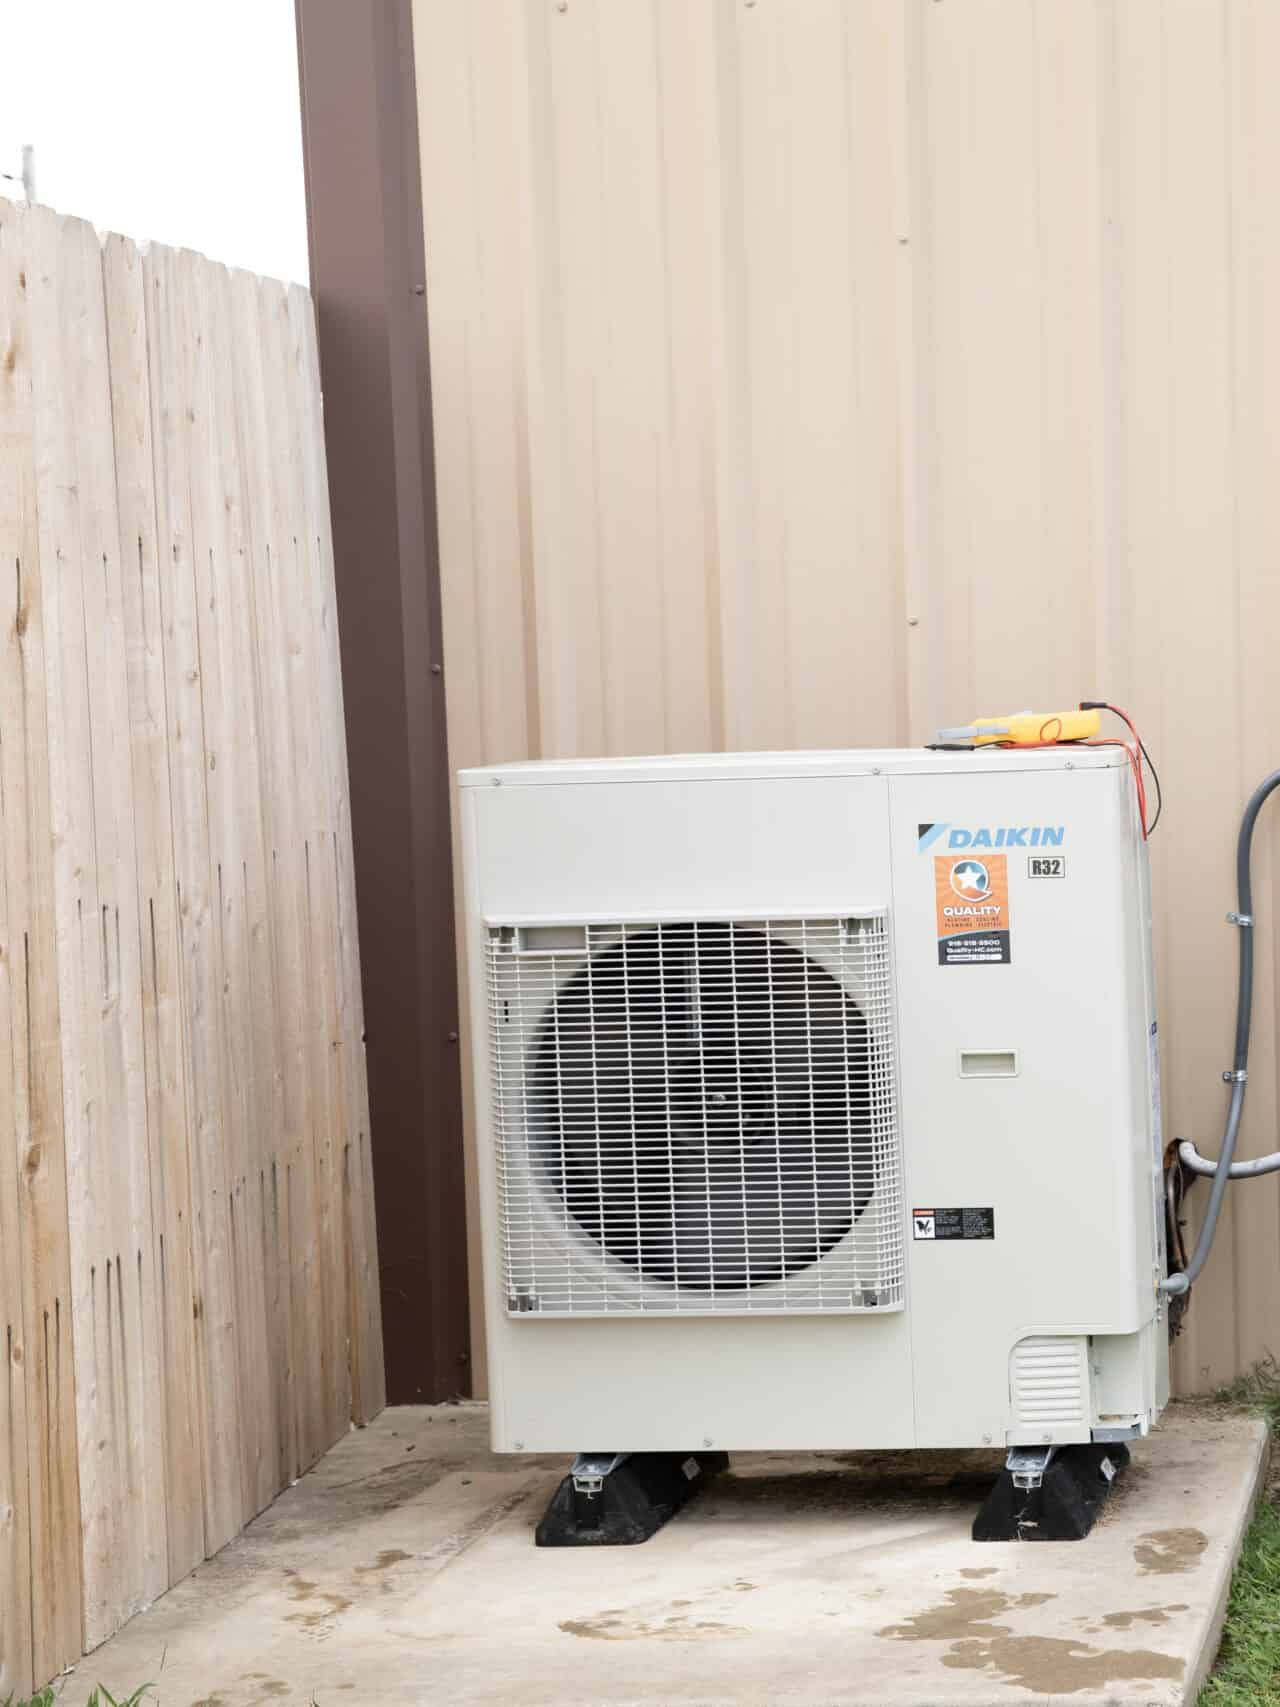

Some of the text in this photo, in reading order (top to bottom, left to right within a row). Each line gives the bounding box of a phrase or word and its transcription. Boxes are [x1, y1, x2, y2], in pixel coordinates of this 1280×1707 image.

[949, 827, 1065, 848] DAIKIN
[1032, 860, 1061, 875] R32
[943, 906, 1001, 916] QUALITY
